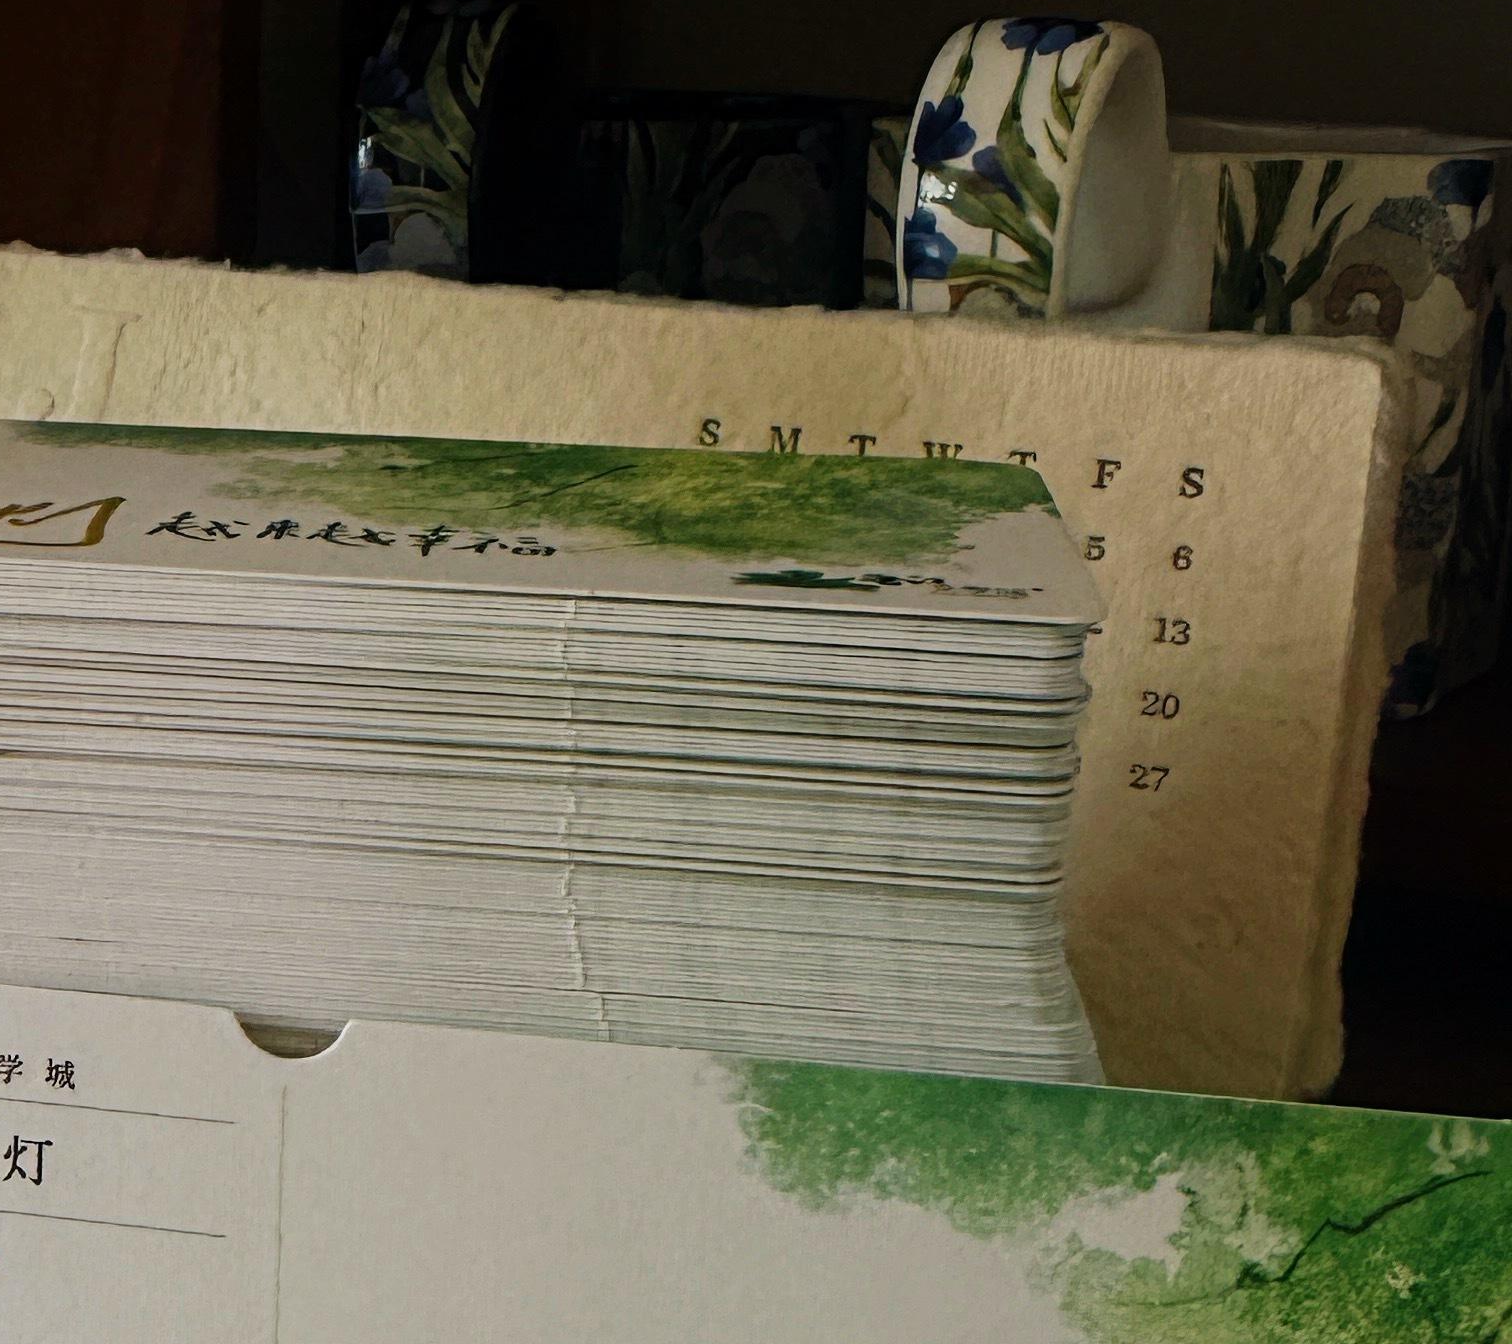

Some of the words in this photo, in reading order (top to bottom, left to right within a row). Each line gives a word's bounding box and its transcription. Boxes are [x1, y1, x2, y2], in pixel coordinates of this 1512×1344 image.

[697, 417, 722, 447] S
[769, 425, 802, 454] M
[847, 433, 877, 455] T
[1090, 458, 1122, 490] F
[1178, 466, 1205, 499] S
[1083, 535, 1106, 562] 5
[1172, 544, 1194, 571] 6
[1152, 616, 1191, 646] 13
[1140, 690, 1180, 720] 20
[1128, 763, 1170, 793] 27
